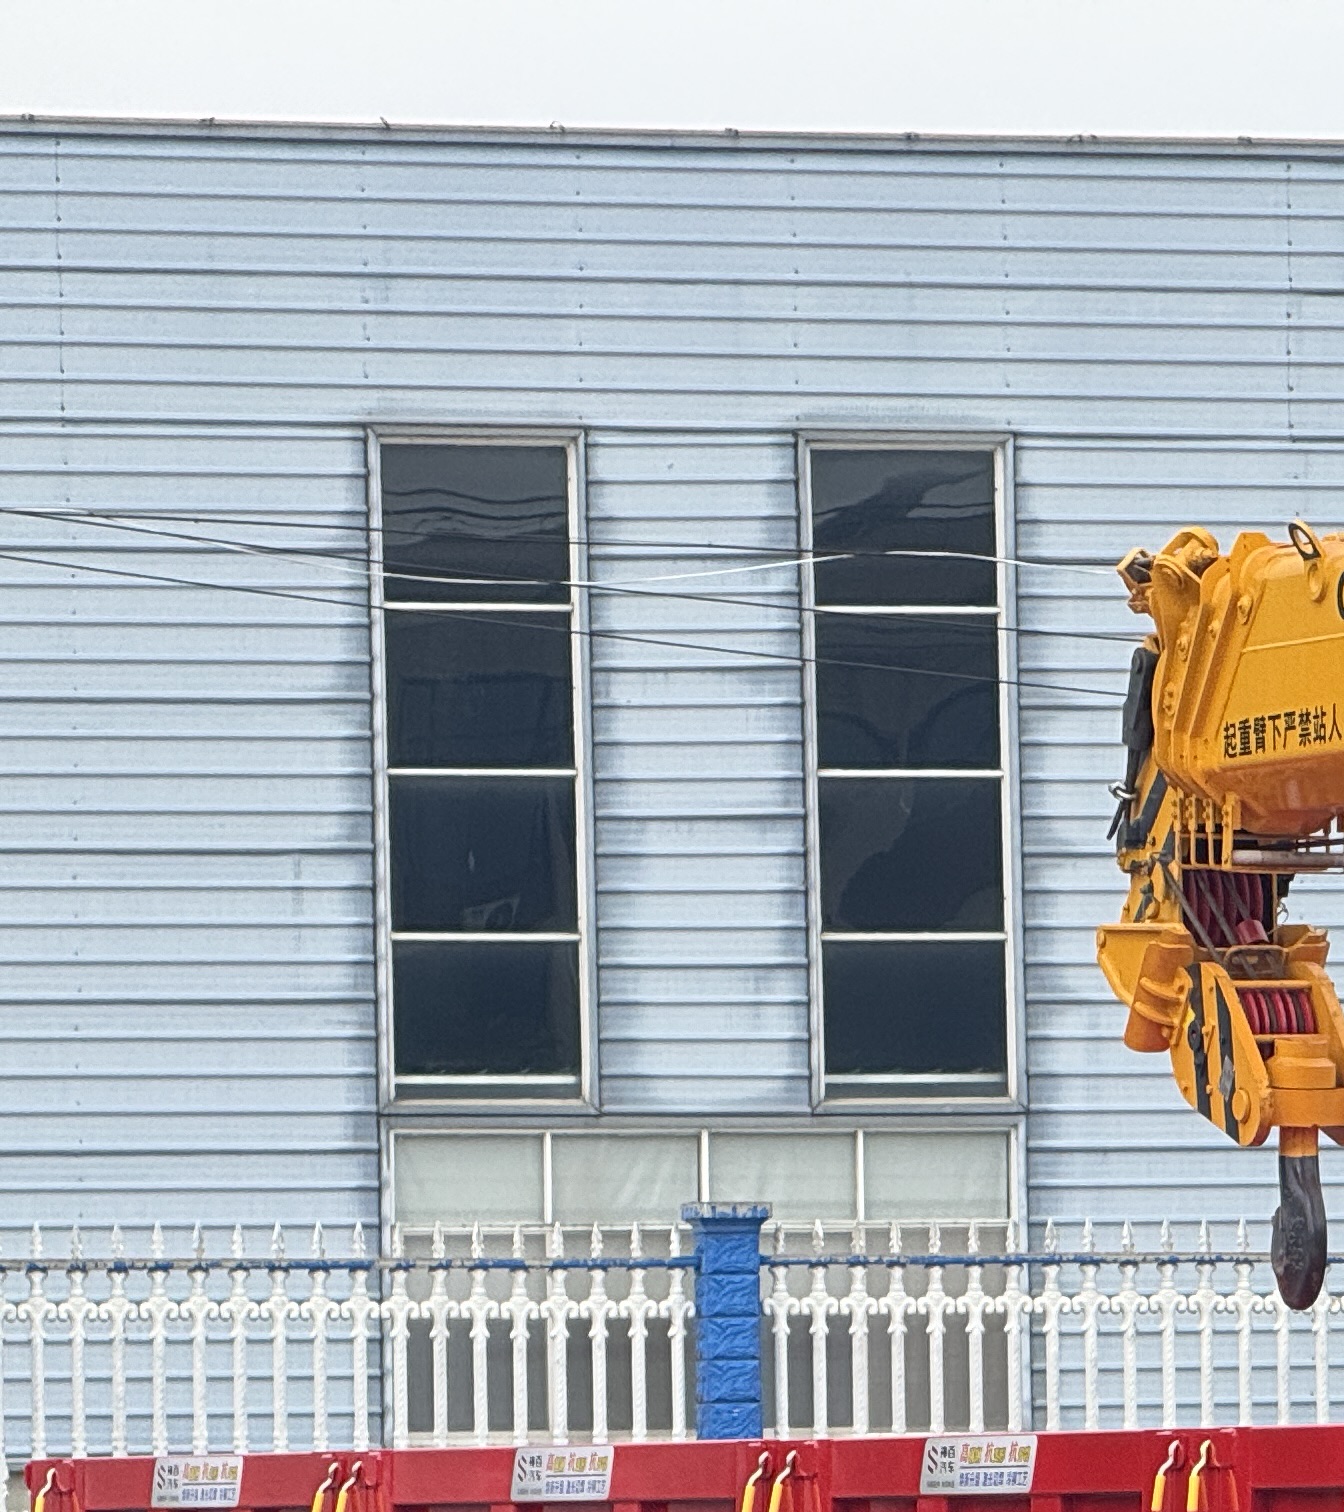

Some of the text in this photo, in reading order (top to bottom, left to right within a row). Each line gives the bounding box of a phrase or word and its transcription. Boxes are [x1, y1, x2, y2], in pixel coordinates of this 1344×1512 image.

[1224, 703, 1342, 759] 起重臂下严禁站人
